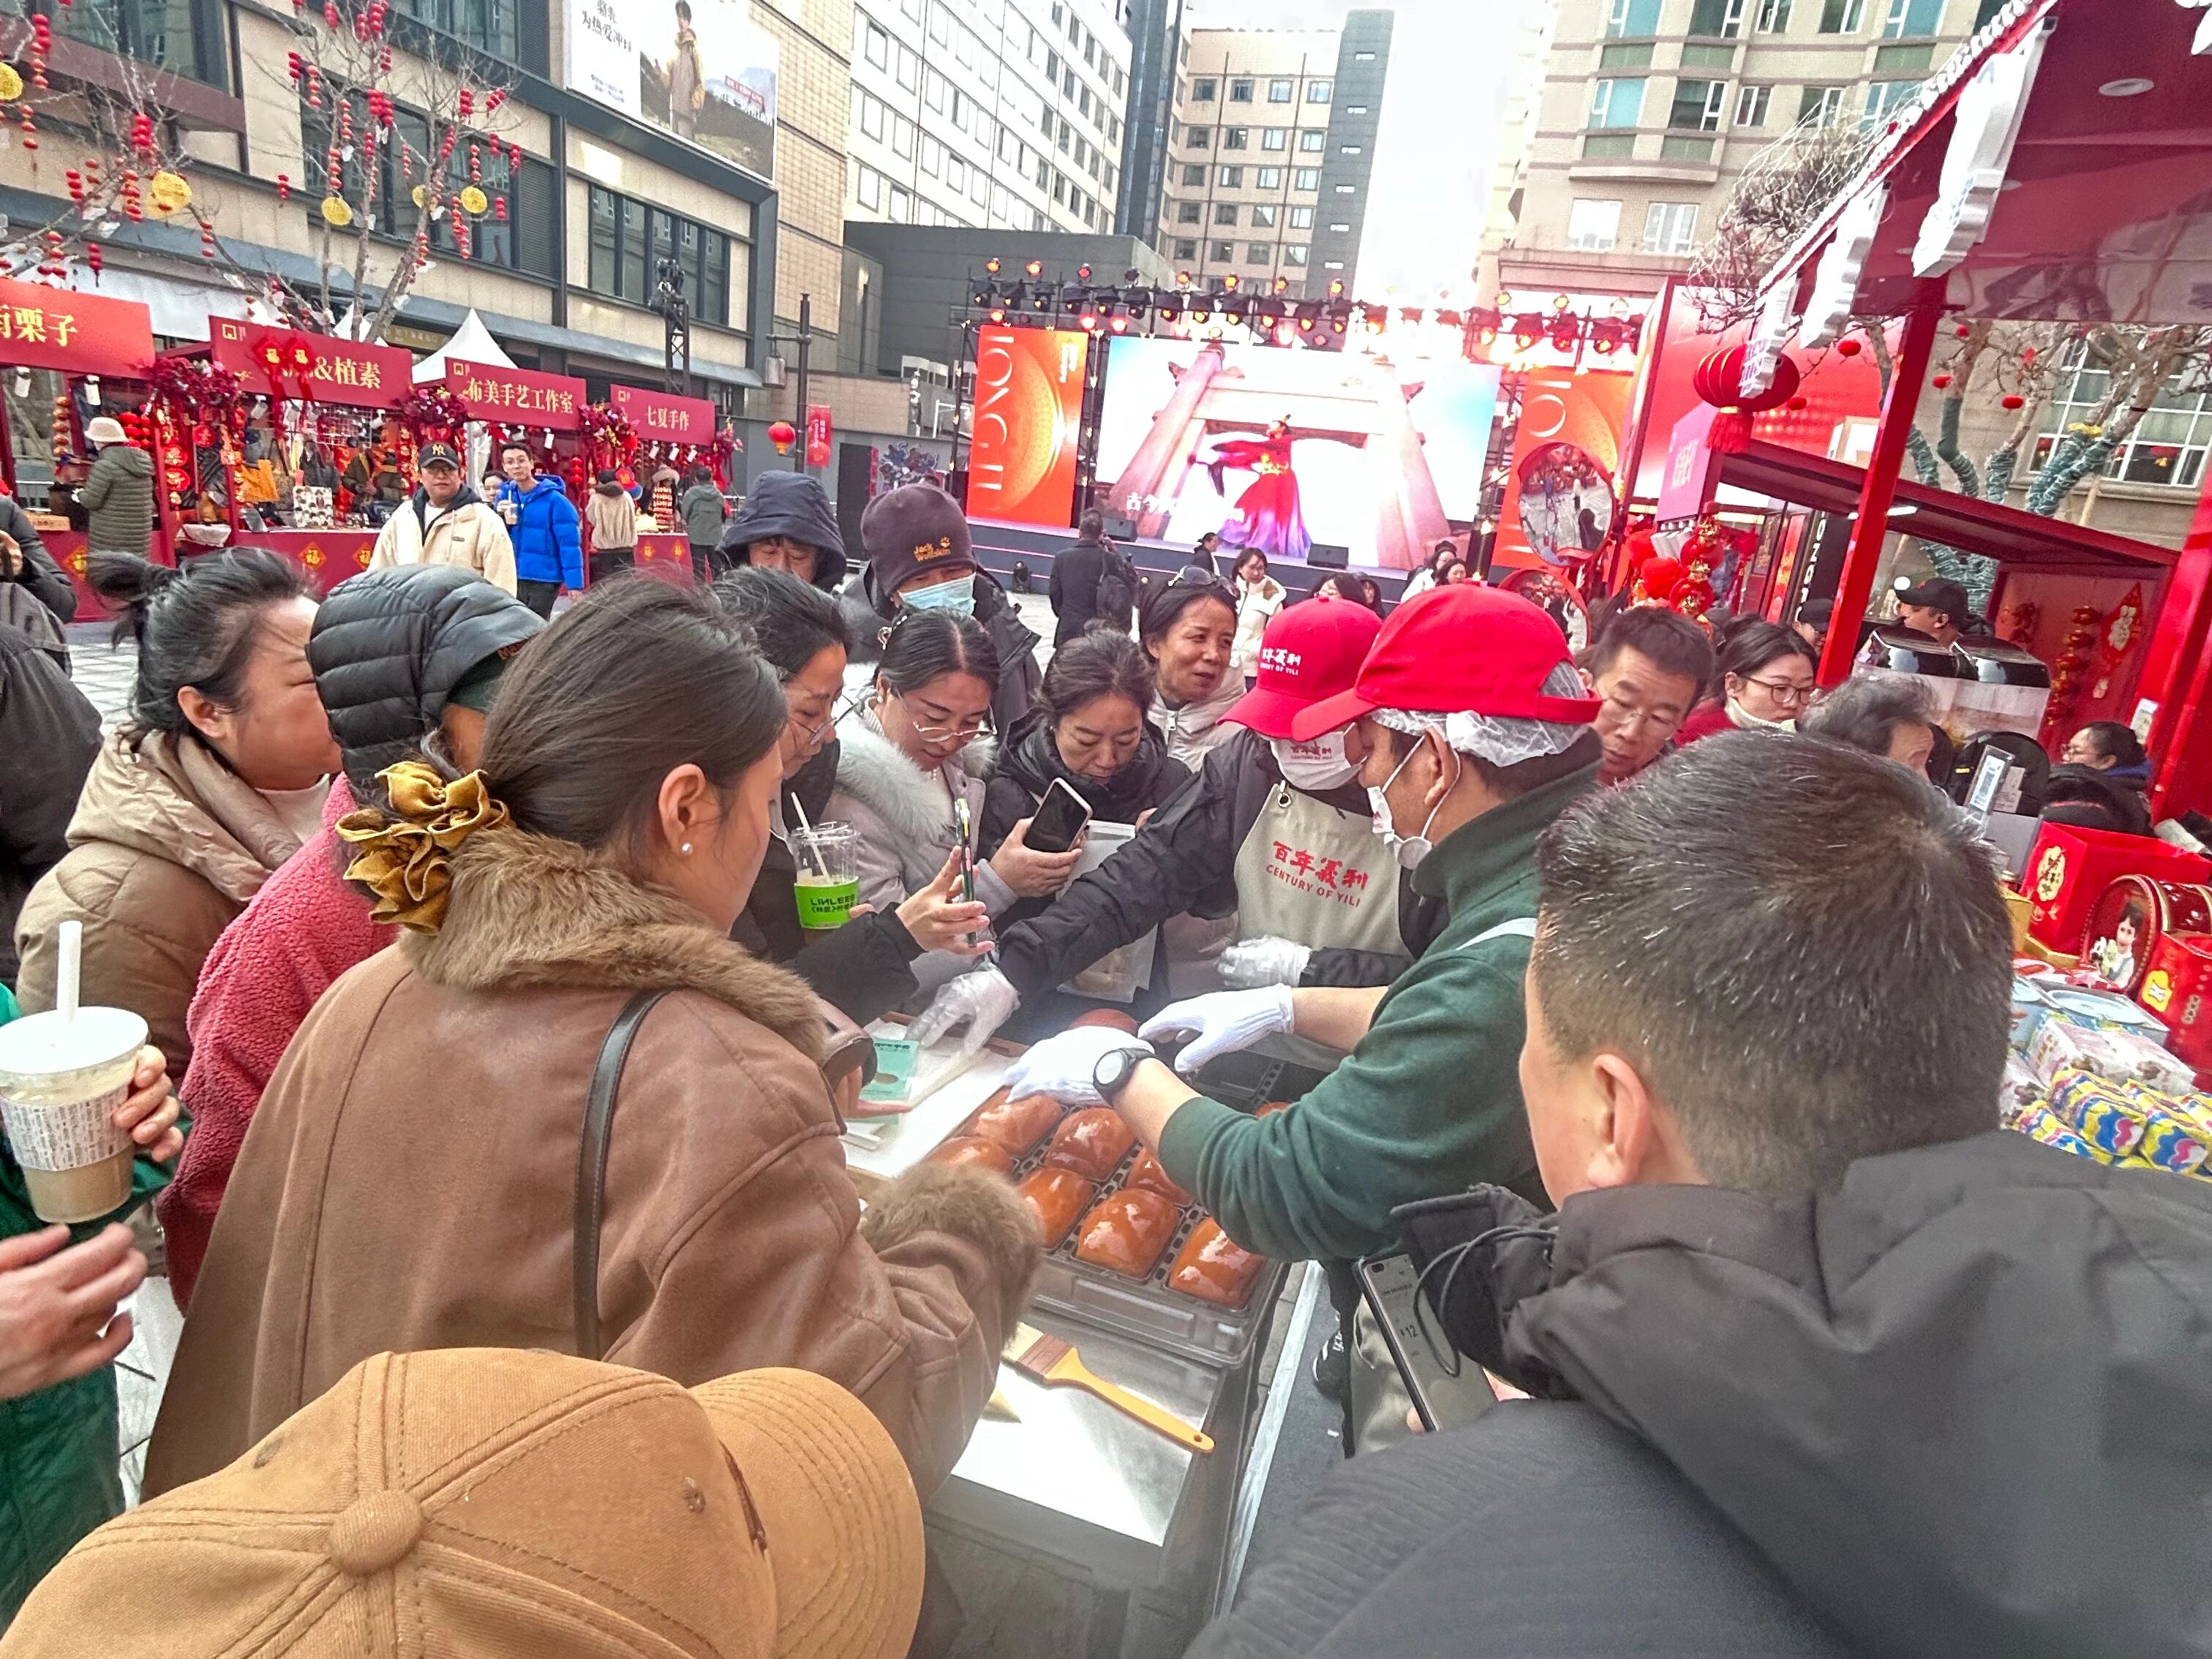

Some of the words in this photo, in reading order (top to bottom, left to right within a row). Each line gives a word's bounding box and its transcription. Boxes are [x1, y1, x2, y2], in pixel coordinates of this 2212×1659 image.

[467, 377, 573, 414] 布美手艺工作室
[647, 405, 690, 431] 七夏手作
[913, 543, 933, 554] Jack
[1265, 864, 1314, 892] CENTURY
[1317, 887, 1333, 899] OF
[1336, 891, 1361, 907] YILI
